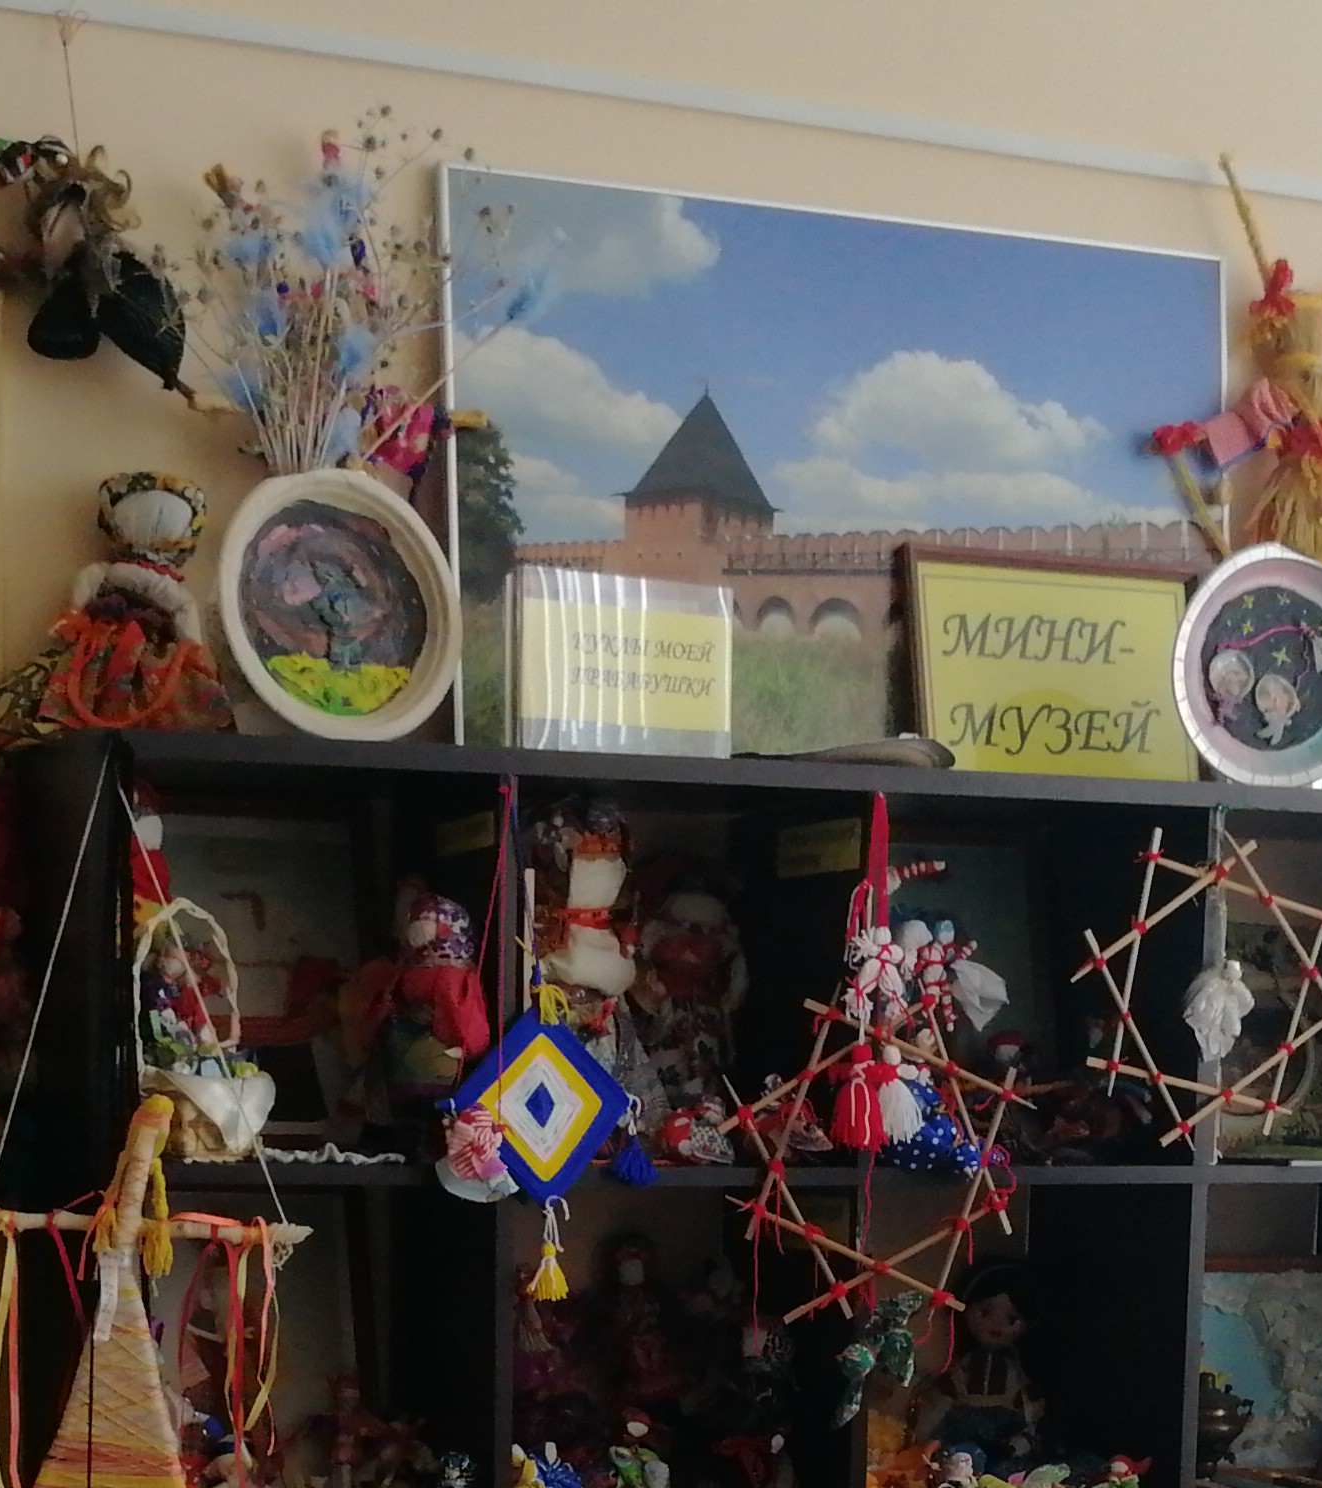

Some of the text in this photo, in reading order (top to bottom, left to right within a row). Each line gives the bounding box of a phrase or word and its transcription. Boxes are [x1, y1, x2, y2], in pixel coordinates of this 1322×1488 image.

[573, 632, 716, 663] КУКЛЫ МОЕЙ
[942, 611, 1135, 664] МИНИ-
[949, 701, 1162, 756] МУЗЕЙ
